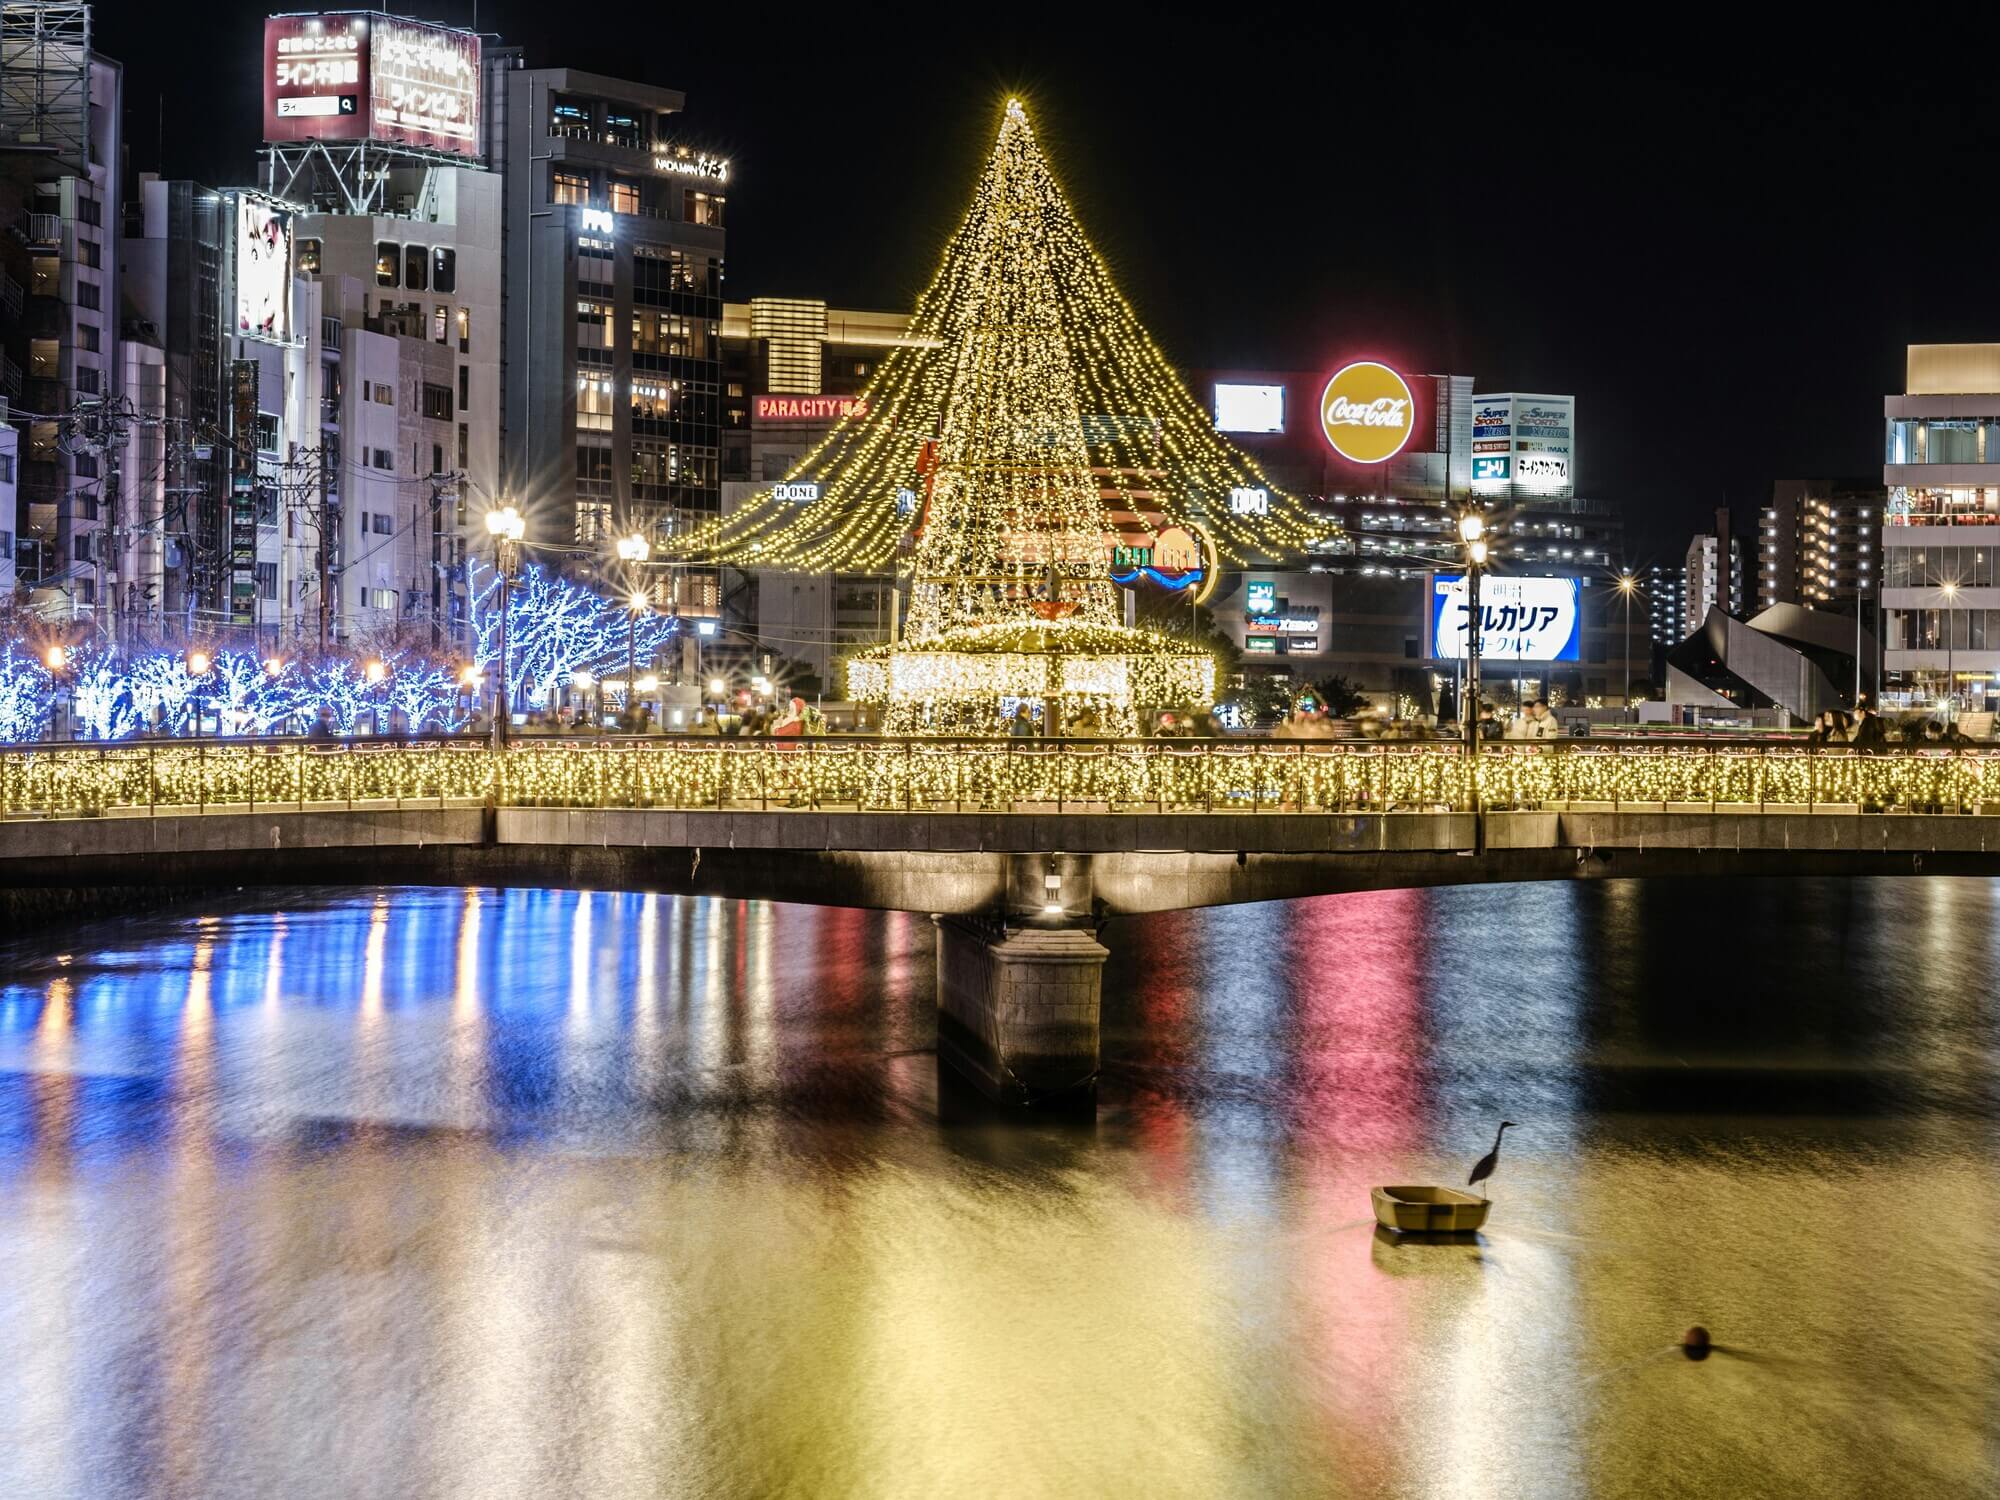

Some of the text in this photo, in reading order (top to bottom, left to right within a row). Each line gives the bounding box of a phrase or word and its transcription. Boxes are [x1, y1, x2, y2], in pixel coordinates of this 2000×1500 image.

[277, 60, 358, 86] ライン不
[759, 400, 797, 417] PARA
[801, 400, 837, 417] CITY
[1478, 460, 1504, 476] ニトリ
